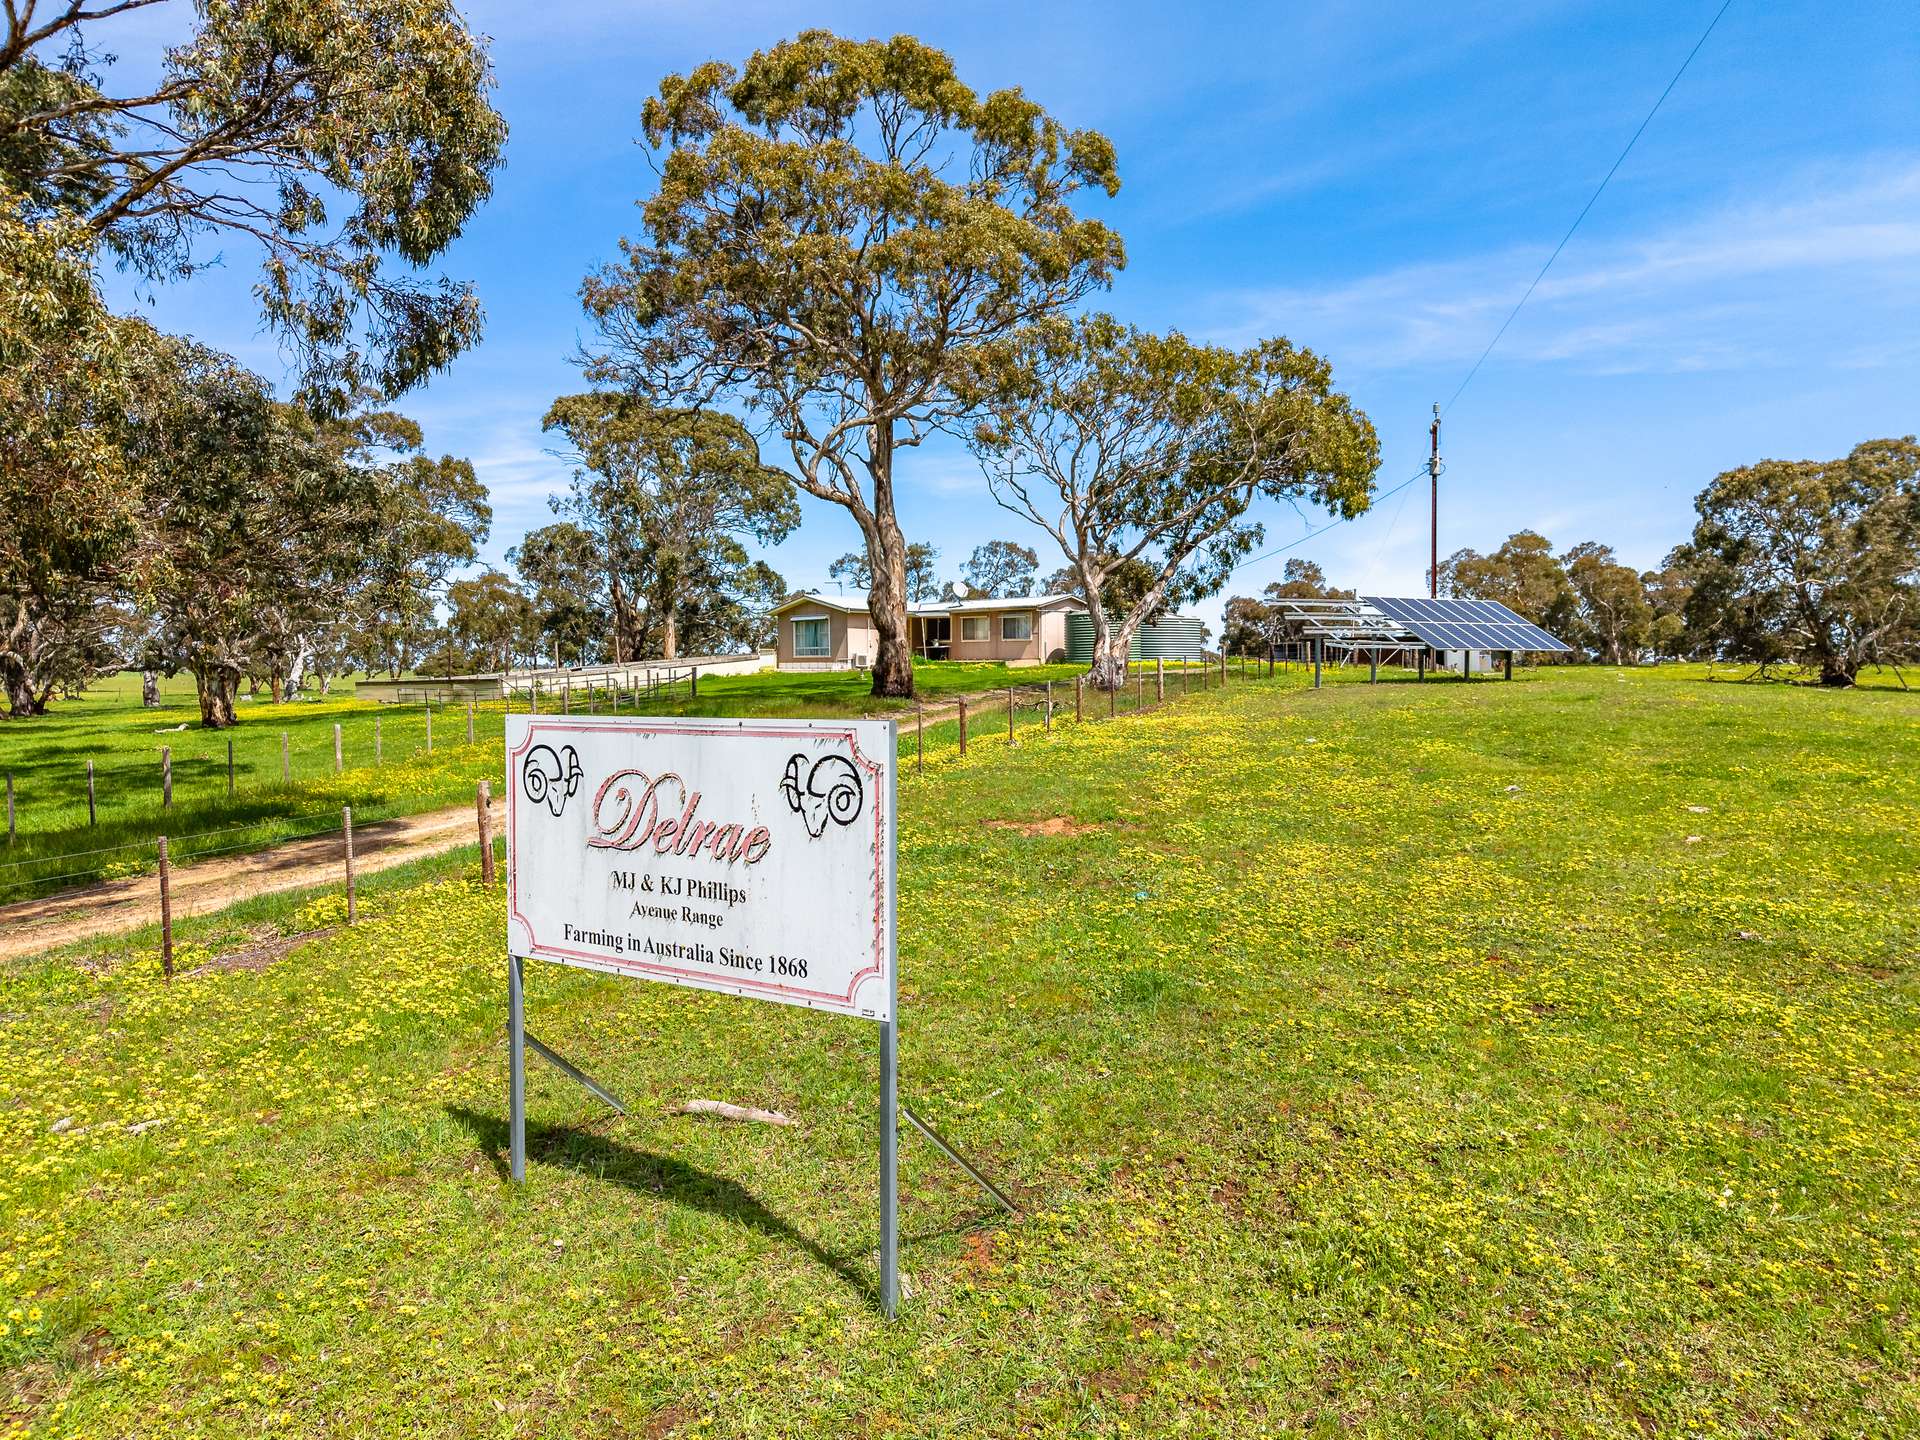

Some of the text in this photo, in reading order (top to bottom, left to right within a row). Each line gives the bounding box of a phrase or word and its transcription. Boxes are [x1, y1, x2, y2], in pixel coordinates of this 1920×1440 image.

[586, 769, 771, 863] Delrae
[612, 870, 746, 908] MJ & KJ Phillips
[630, 901, 724, 930] Avenue Range
[564, 923, 808, 979] Farming in Australia Since 1868
